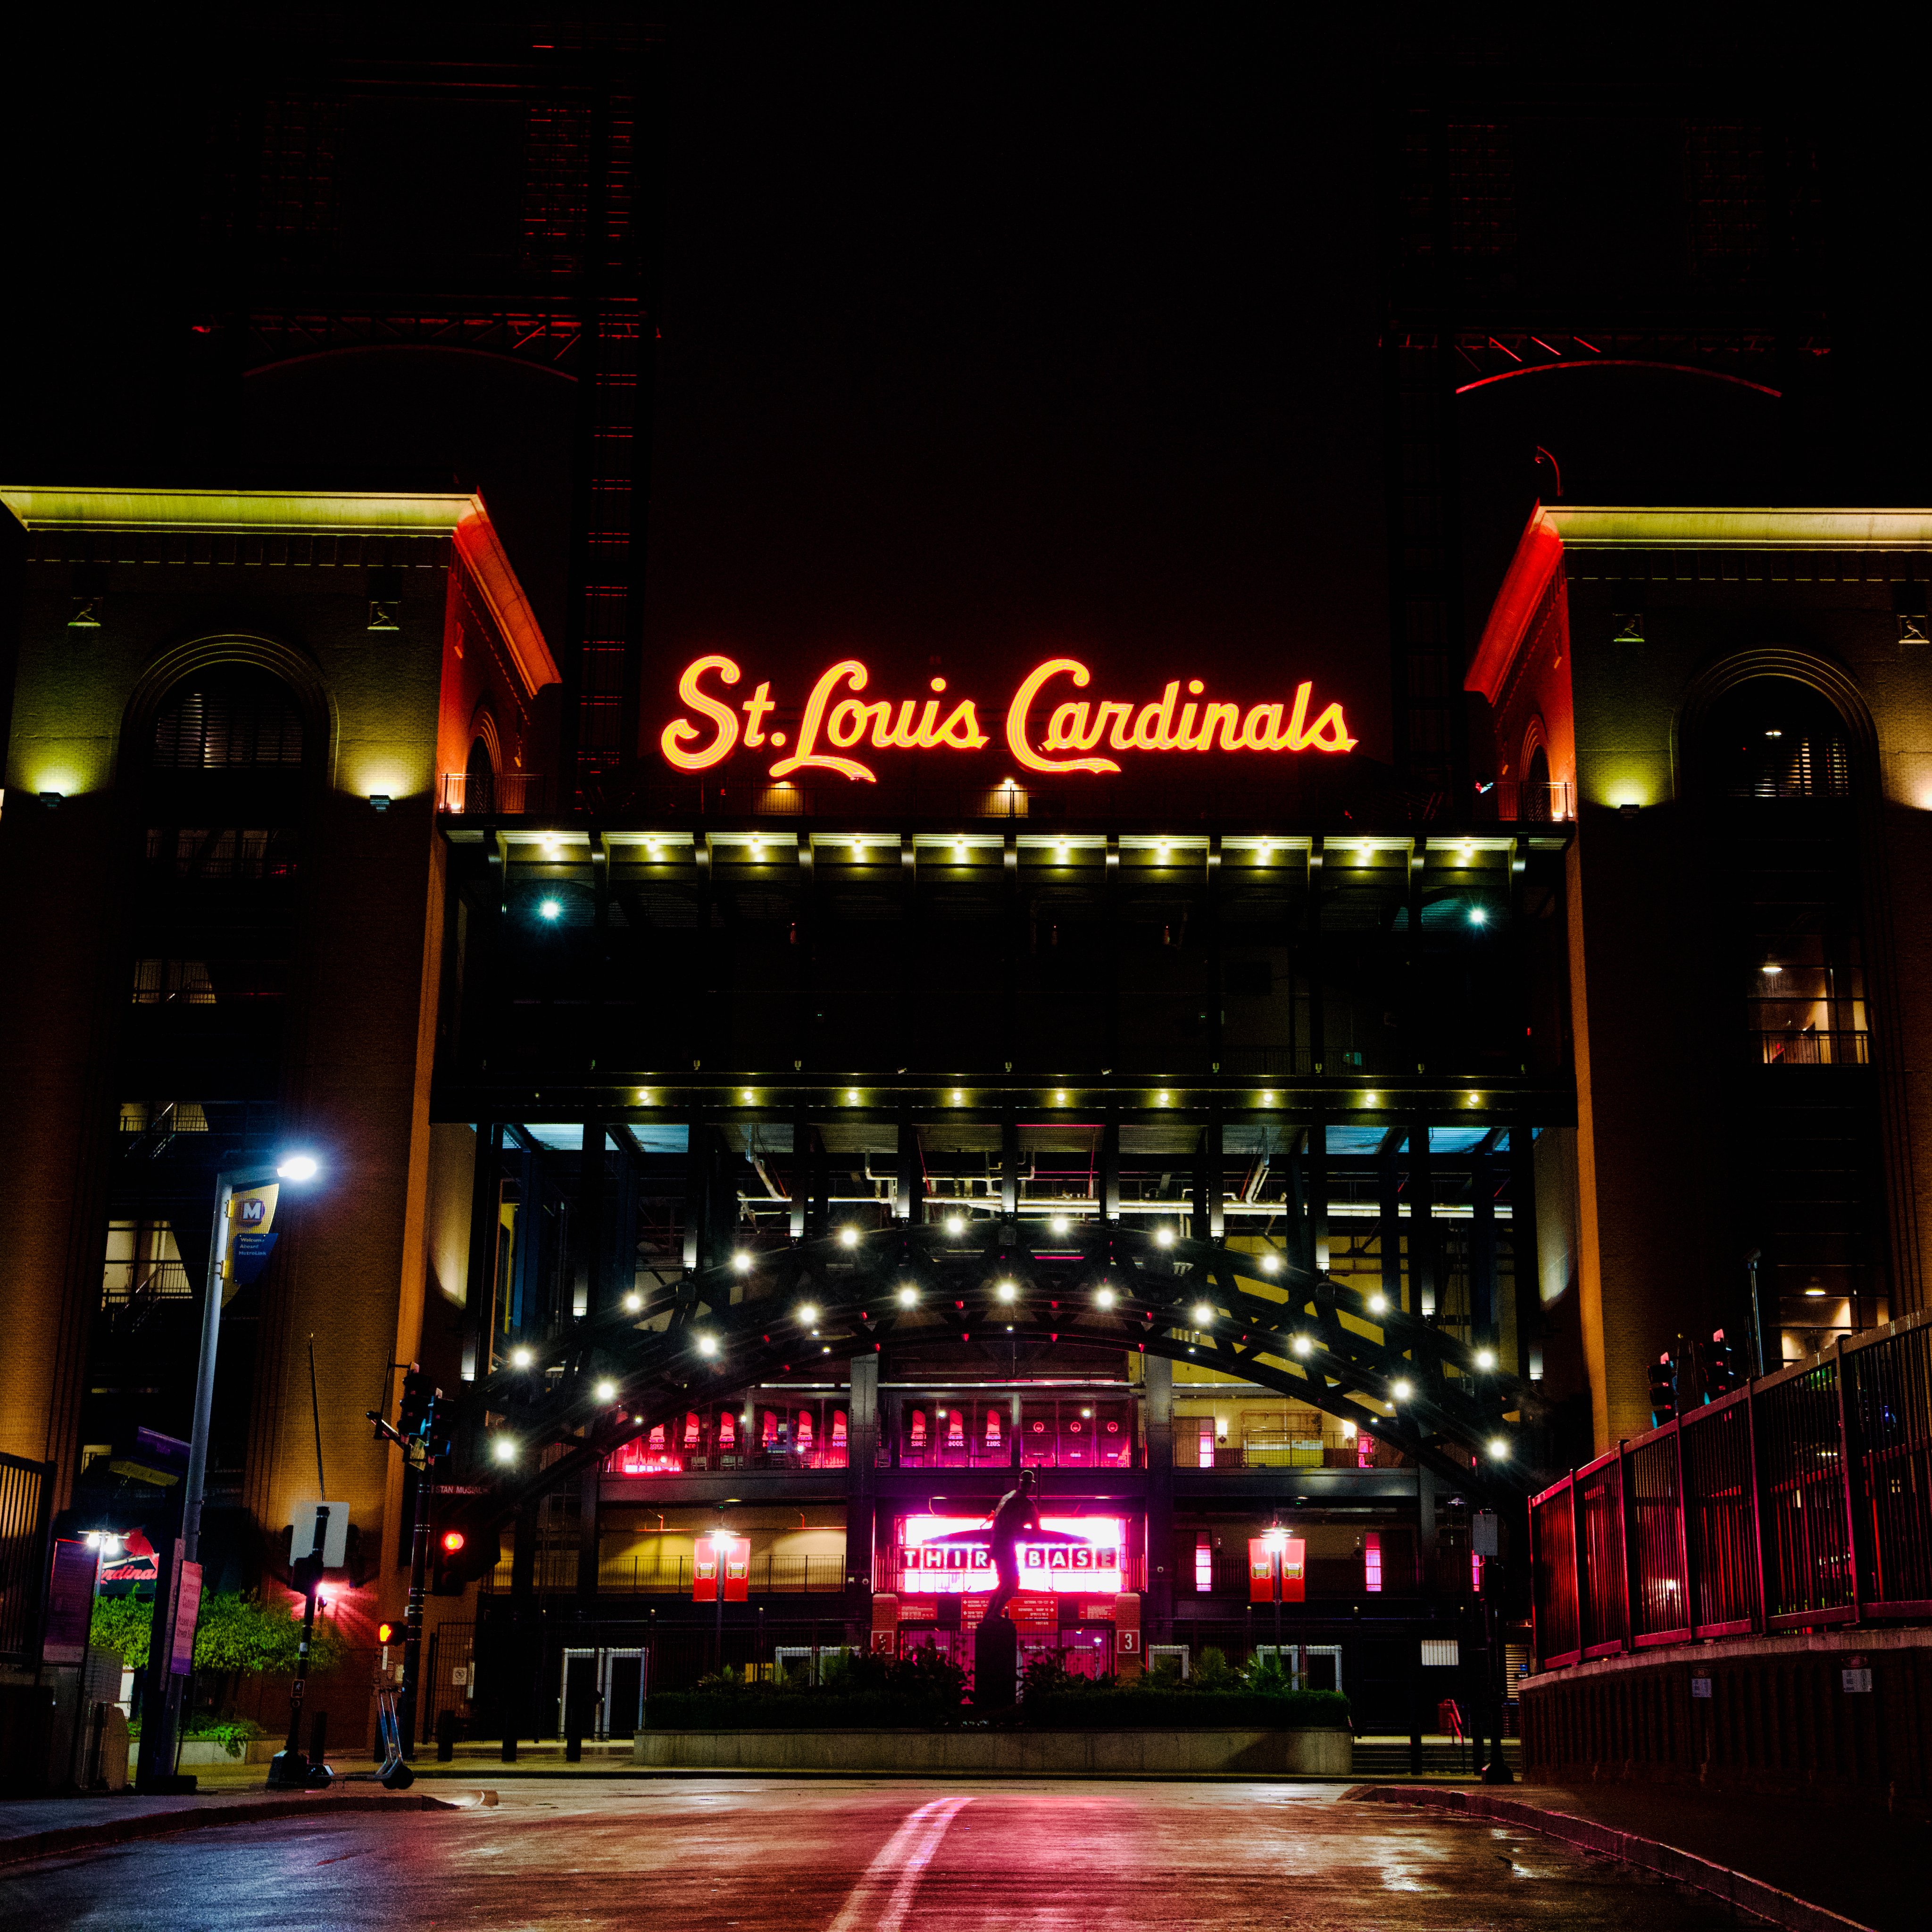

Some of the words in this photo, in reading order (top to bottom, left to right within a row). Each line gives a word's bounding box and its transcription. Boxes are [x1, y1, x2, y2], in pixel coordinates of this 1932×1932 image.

[661, 656, 785, 769] St.
[769, 660, 990, 782] Louis
[1007, 658, 1358, 774] Cardinals
[242, 1202, 261, 1219] M
[436, 1485, 454, 1494] STAN
[905, 1551, 987, 1567] THIR
[1029, 1551, 1111, 1567] BASE
[1124, 1633, 1133, 1650] 3
